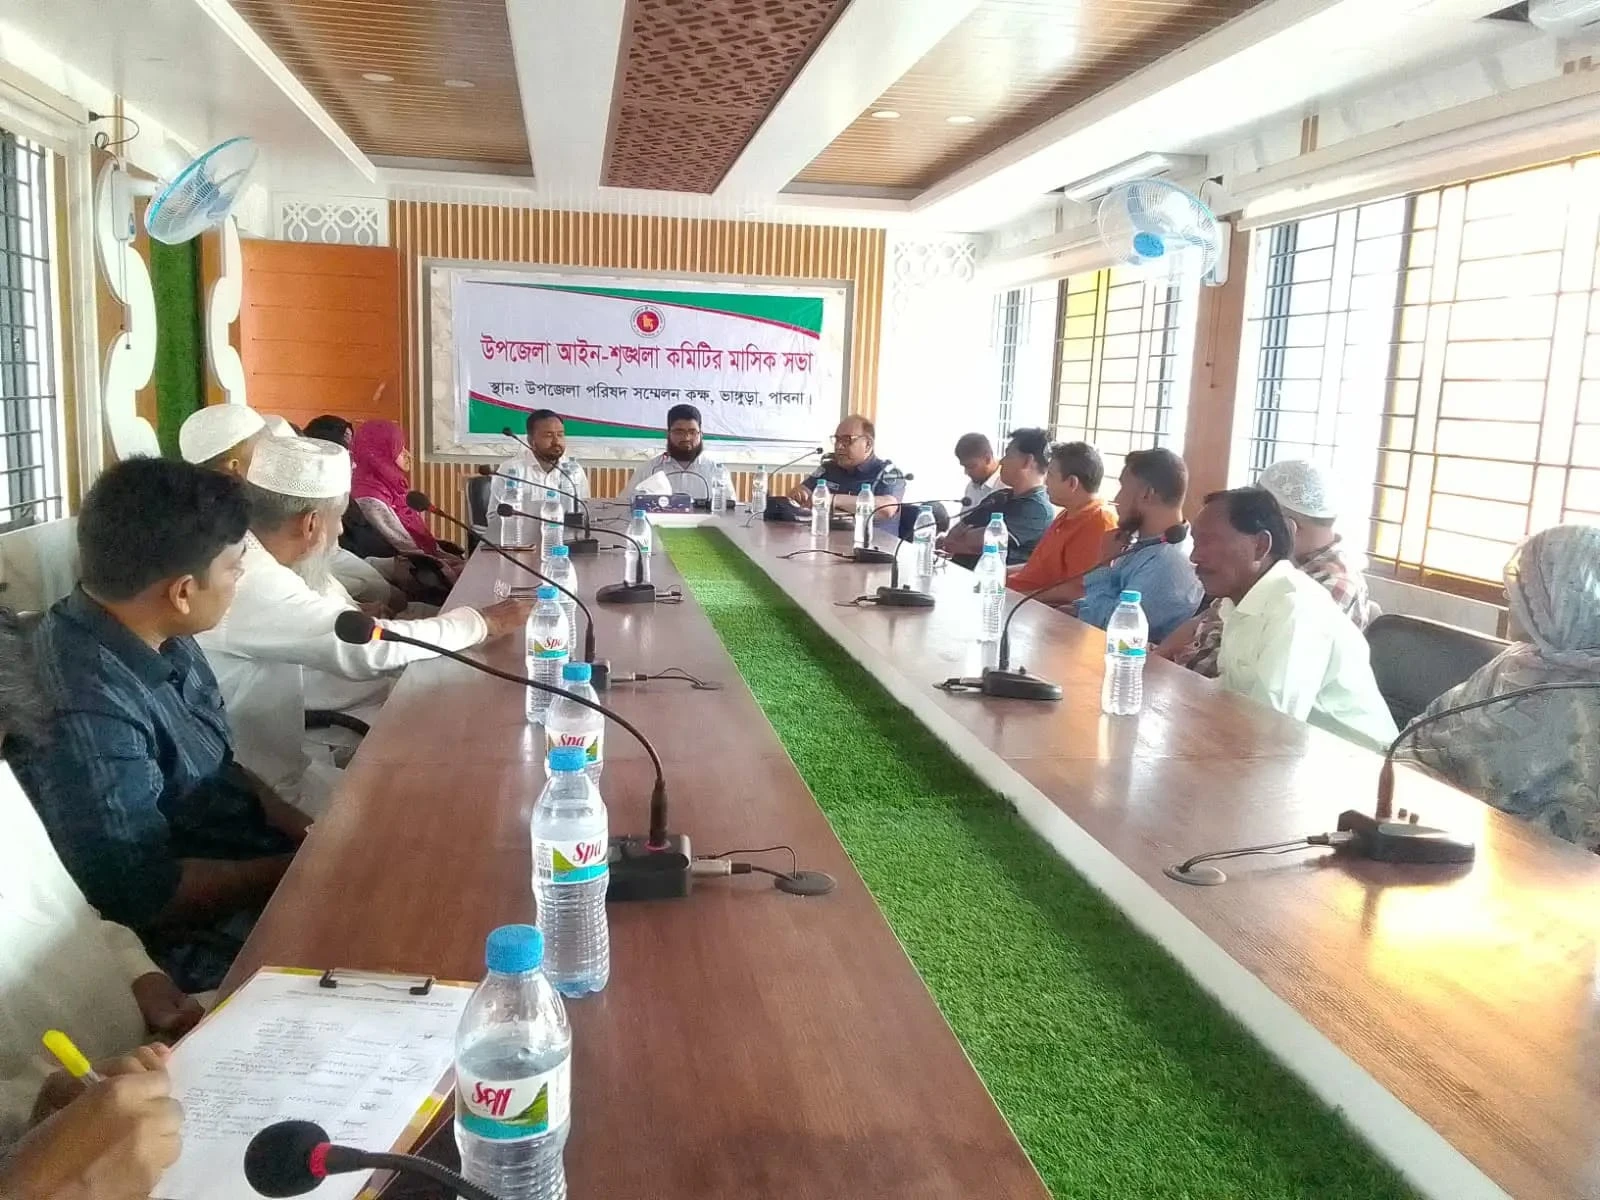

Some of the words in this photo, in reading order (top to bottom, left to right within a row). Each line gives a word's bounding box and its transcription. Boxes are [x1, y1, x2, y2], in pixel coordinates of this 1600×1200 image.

[480, 332, 551, 366] উপজেলা
[556, 336, 660, 376] আইন-শৃঙ্খলা
[666, 340, 723, 371] কমিটির
[728, 343, 778, 373] মাসিক
[782, 351, 813, 374] সভা
[489, 380, 519, 398] স্থান:
[525, 379, 580, 398] উপজেলা
[586, 382, 628, 400] পরিষদ
[633, 387, 681, 401] সম্মেলন
[685, 388, 714, 404] কক্ষ,
[573, 840, 602, 864] Spa
